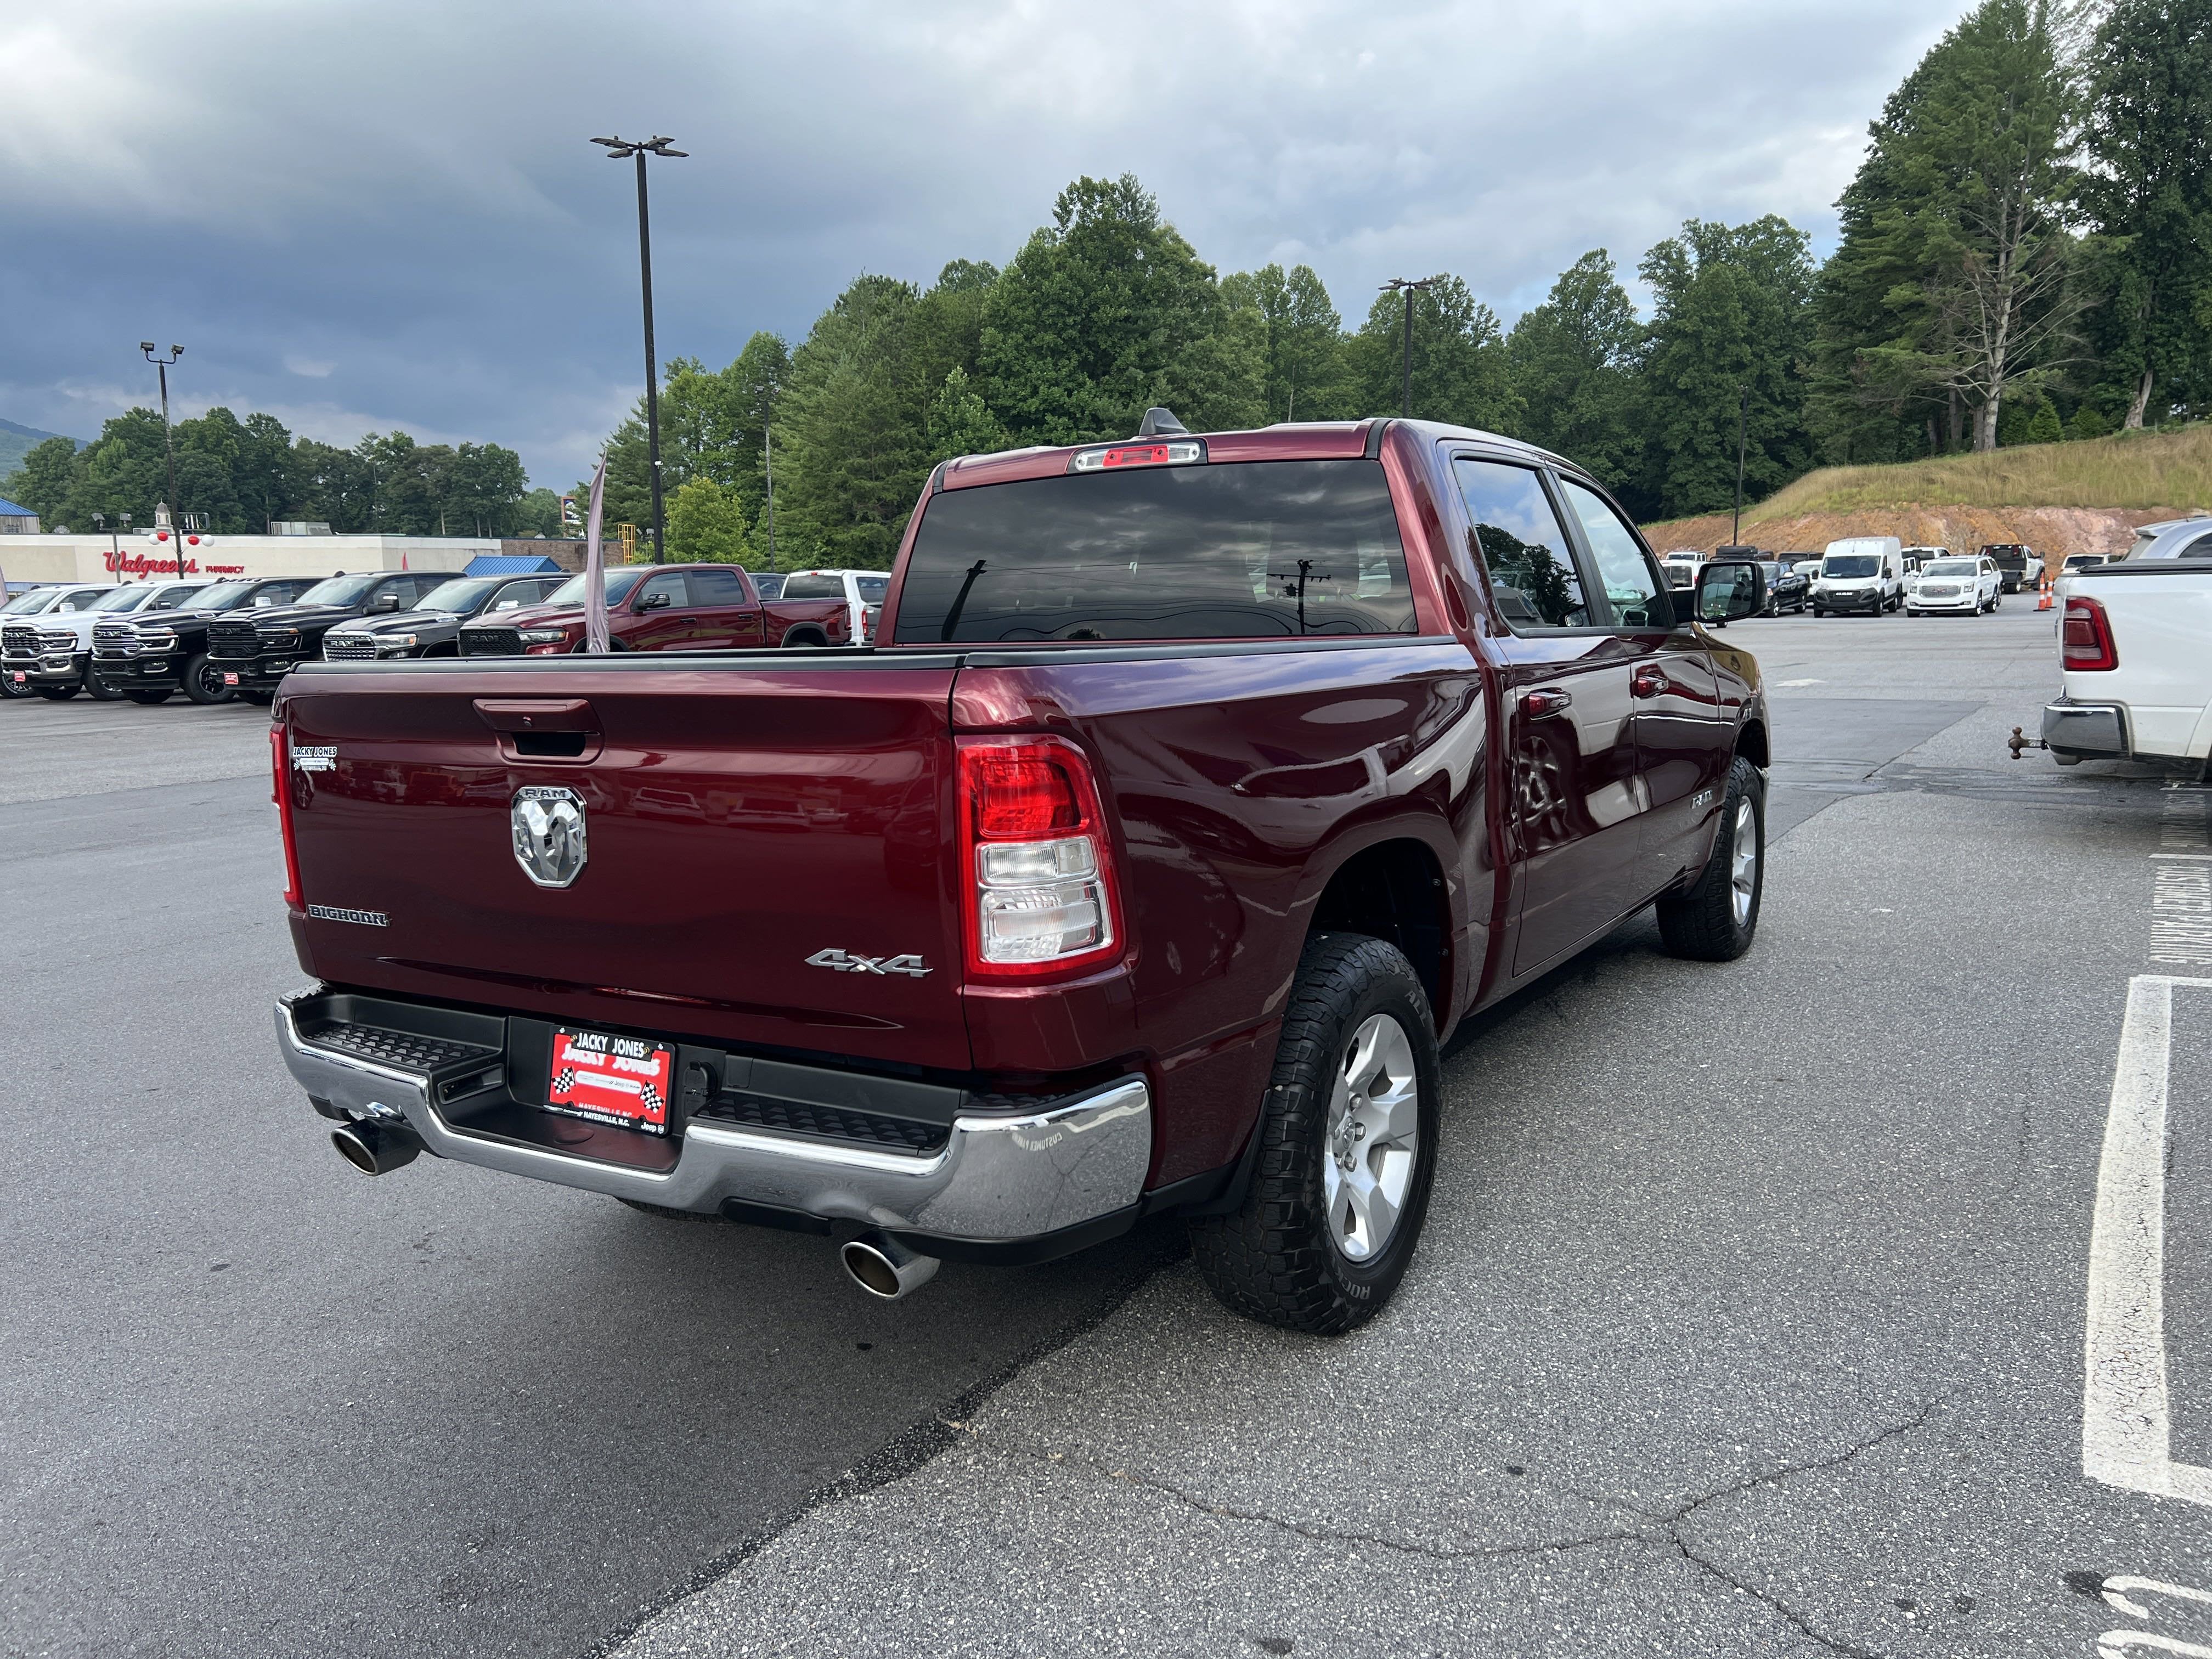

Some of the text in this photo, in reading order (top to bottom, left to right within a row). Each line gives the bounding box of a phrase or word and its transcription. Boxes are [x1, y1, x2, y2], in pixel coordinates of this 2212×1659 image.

[103, 551, 245, 579] Walgrees PHARMACY
[294, 747, 337, 757] JACKY JONES
[524, 788, 567, 798] RAM
[2153, 866, 2211, 911] CUSTOMER
[309, 904, 389, 927] BIGHORN
[577, 1032, 645, 1058] JACKY JONES
[641, 1121, 657, 1133] Jeep
